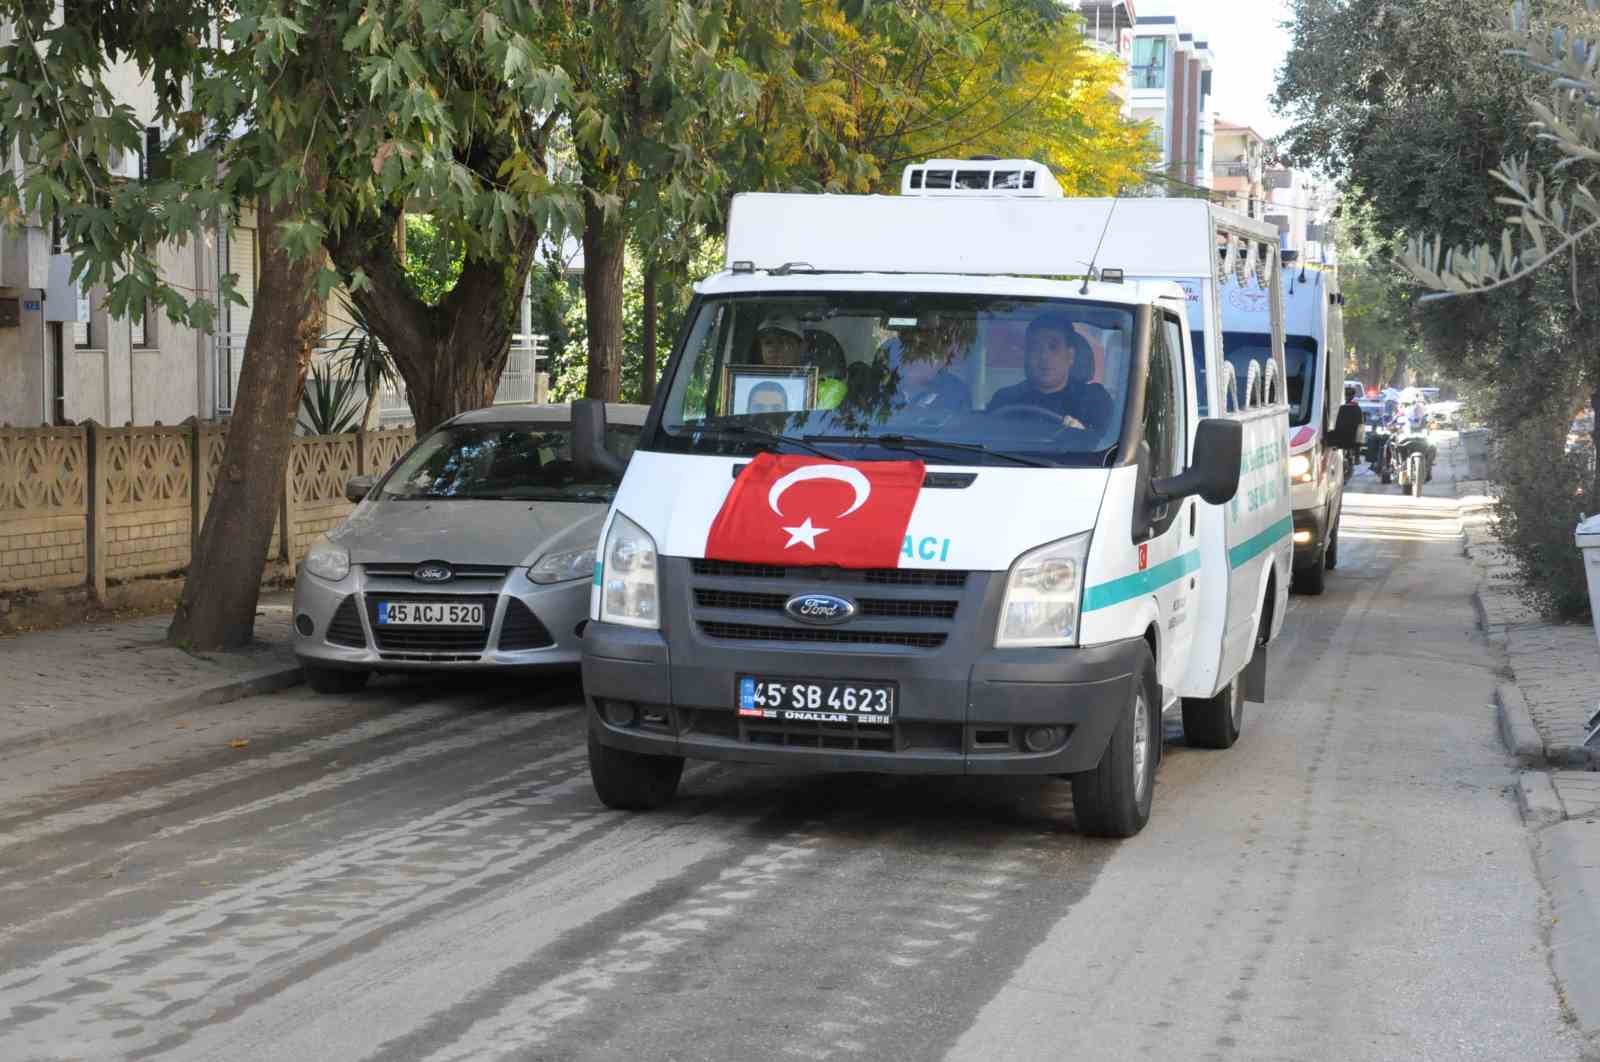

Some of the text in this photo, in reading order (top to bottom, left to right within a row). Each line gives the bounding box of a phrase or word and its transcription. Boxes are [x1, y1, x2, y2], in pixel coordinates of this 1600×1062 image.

[388, 604, 481, 623] 45 ACJ 520
[800, 598, 839, 616] Ford
[752, 681, 888, 713] 45 SB 4623
